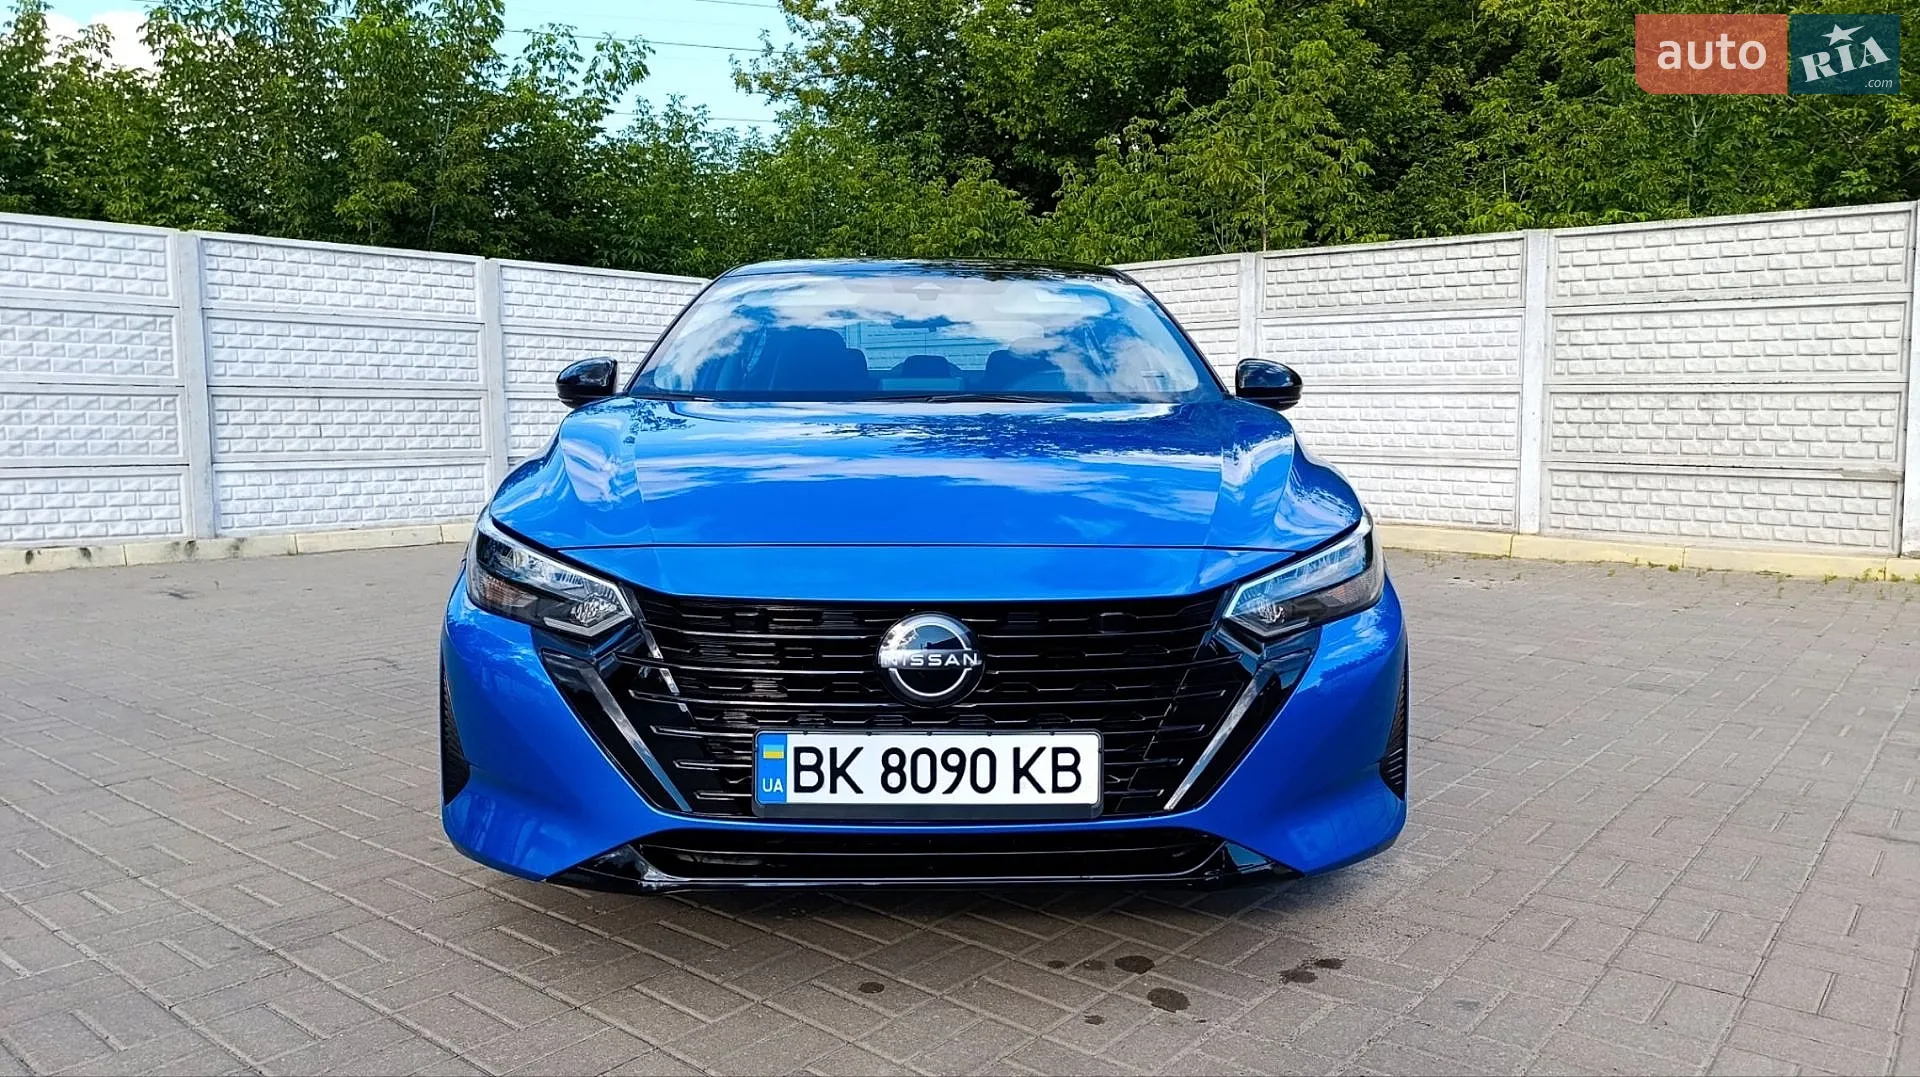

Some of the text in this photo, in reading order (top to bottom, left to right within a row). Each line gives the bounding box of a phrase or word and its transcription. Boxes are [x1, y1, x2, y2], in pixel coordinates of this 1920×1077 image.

[883, 653, 978, 667] NISSAN
[794, 746, 1082, 794] BK 8090 KB
[762, 778, 784, 793] UA
